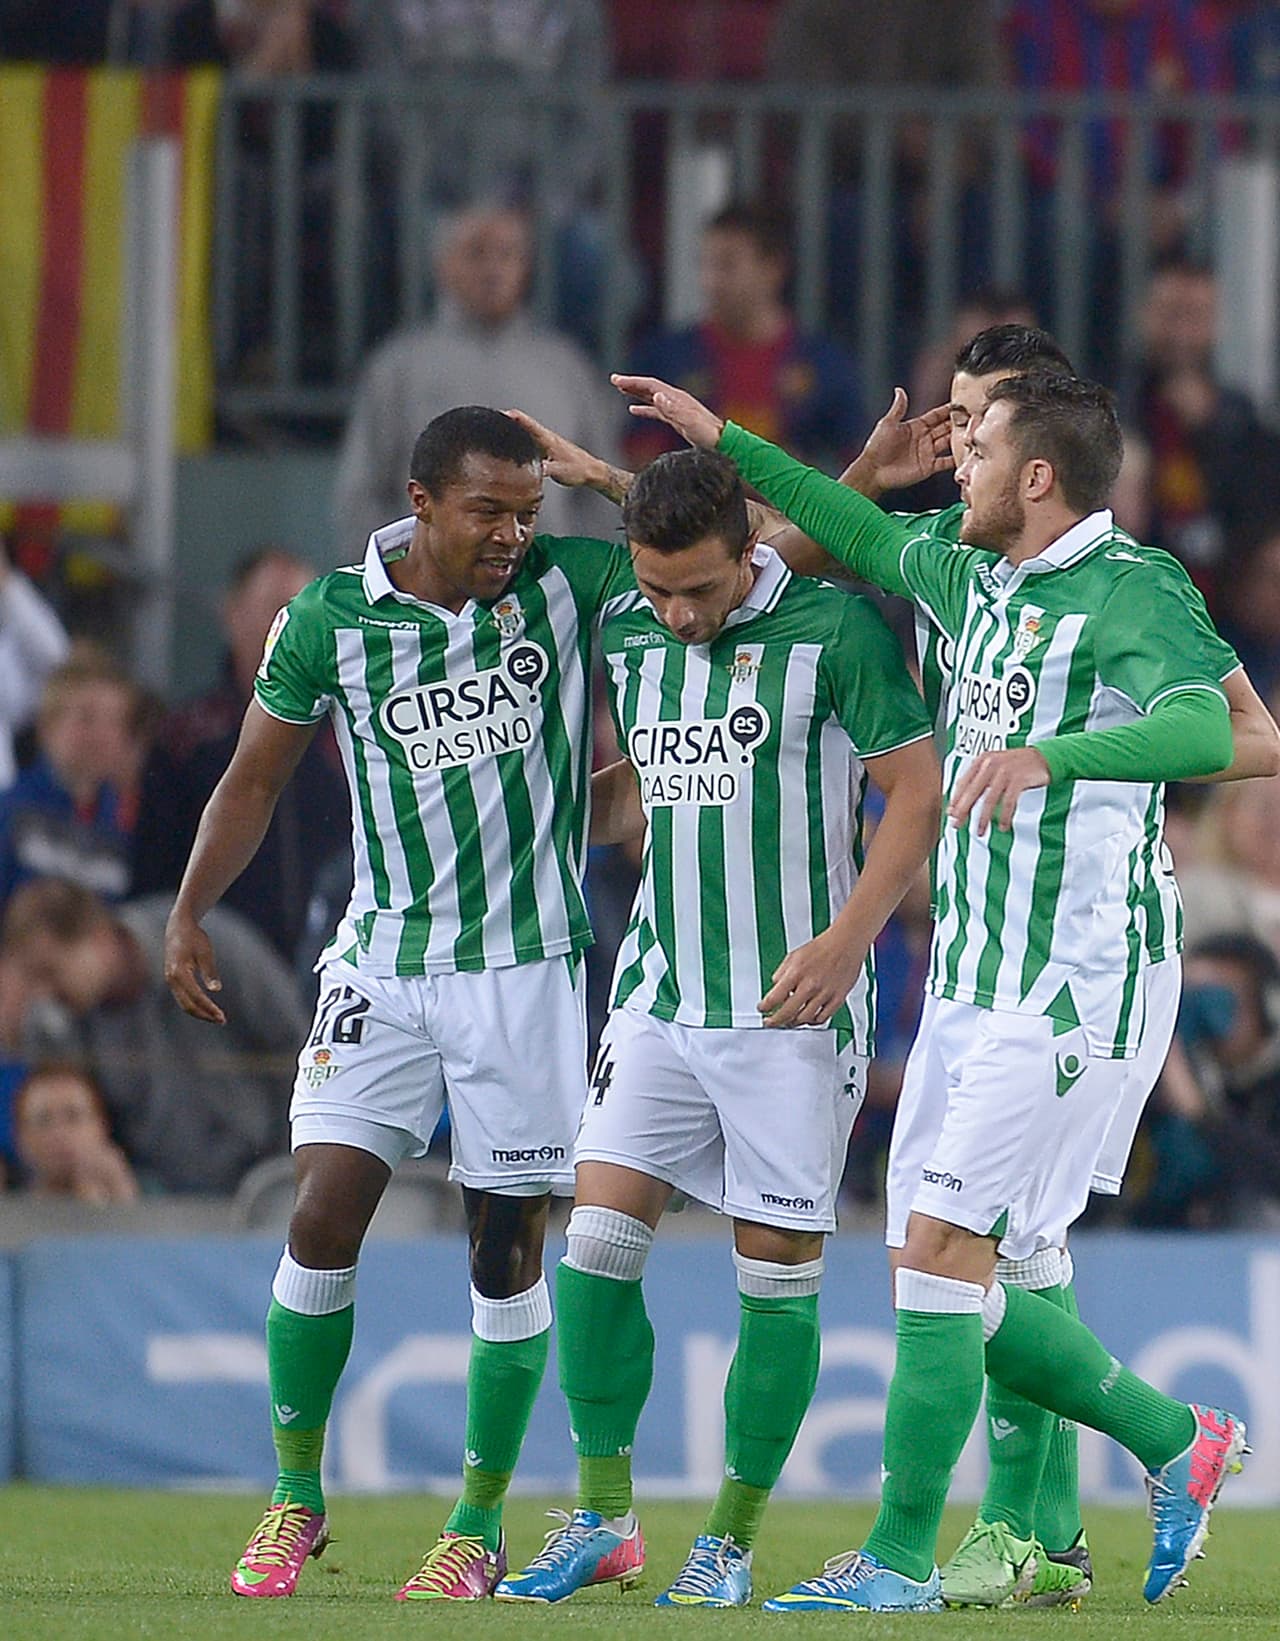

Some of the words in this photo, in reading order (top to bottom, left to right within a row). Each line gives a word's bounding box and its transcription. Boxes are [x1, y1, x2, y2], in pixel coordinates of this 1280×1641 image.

[513, 655, 537, 675] es
[385, 674, 520, 736] CIRSA
[734, 716, 757, 734] es
[411, 717, 532, 769] CASINO
[631, 725, 729, 768] CIRSA
[643, 773, 736, 804] CASINO
[491, 1144, 566, 1163] macron
[922, 1168, 963, 1192] acron
[760, 1191, 815, 1211] macron
